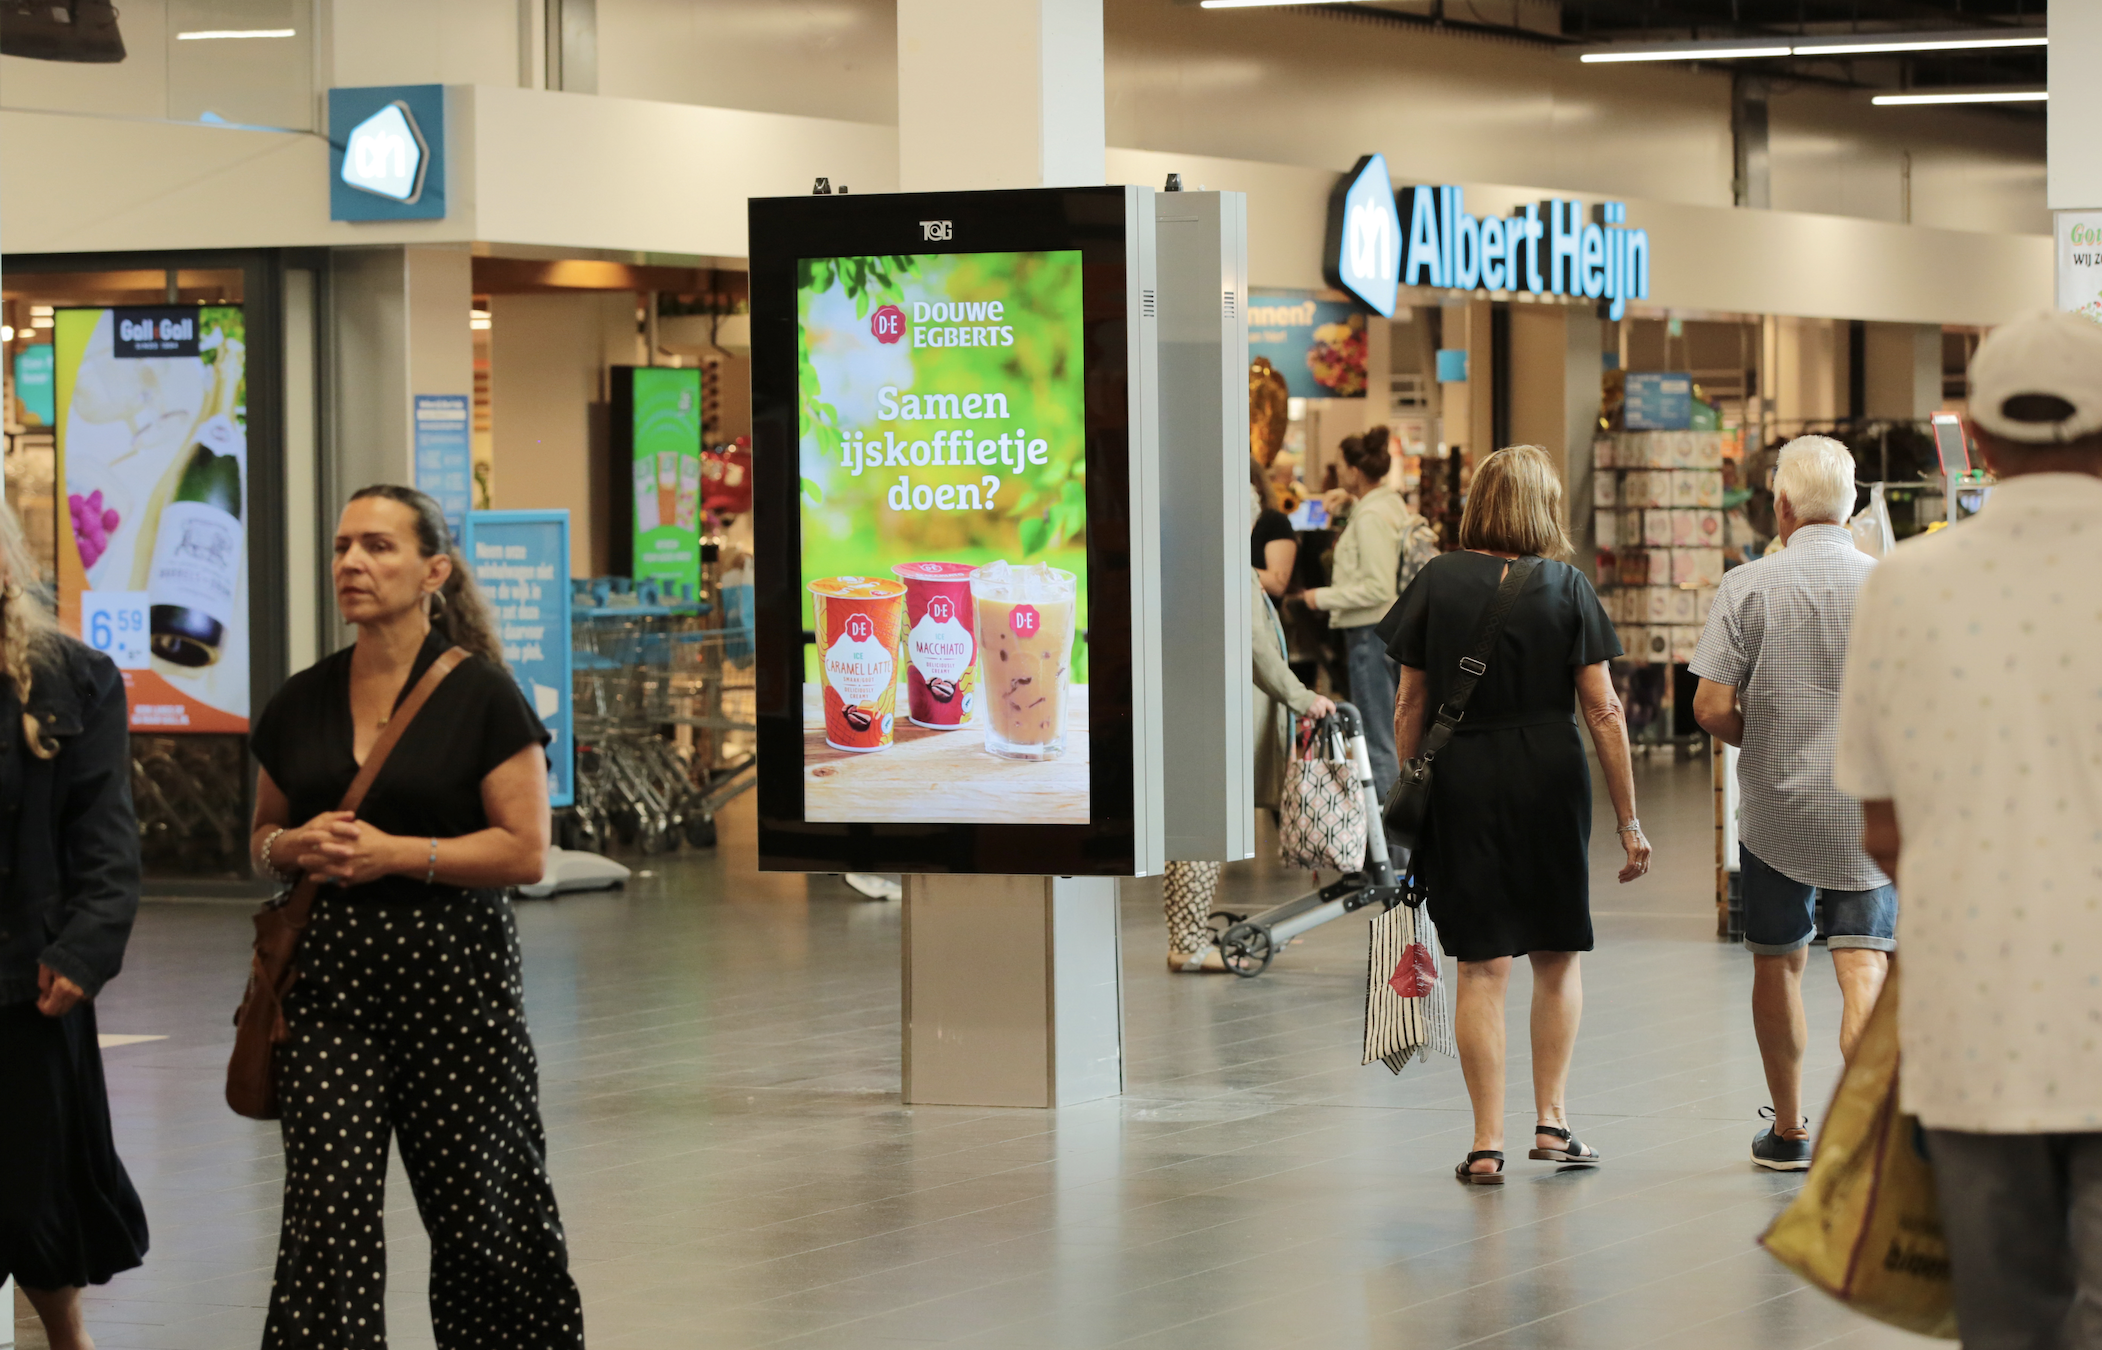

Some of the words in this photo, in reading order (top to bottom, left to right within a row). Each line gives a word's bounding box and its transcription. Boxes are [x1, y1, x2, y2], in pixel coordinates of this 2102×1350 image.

[1405, 184, 1543, 295] Albert
[1550, 198, 1649, 321] Heijn
[2073, 253, 2092, 267] WIJ
[913, 301, 1005, 323] DOUWE
[913, 326, 1014, 347] EGBERTS
[877, 386, 1010, 421] Samen
[840, 428, 1048, 476] ijskoffietje
[888, 475, 1001, 511] doen?
[853, 652, 864, 660] ICE
[916, 641, 965, 655] MACCHIATO
[826, 659, 865, 675] CARAMEL
[867, 660, 892, 675] LATTE
